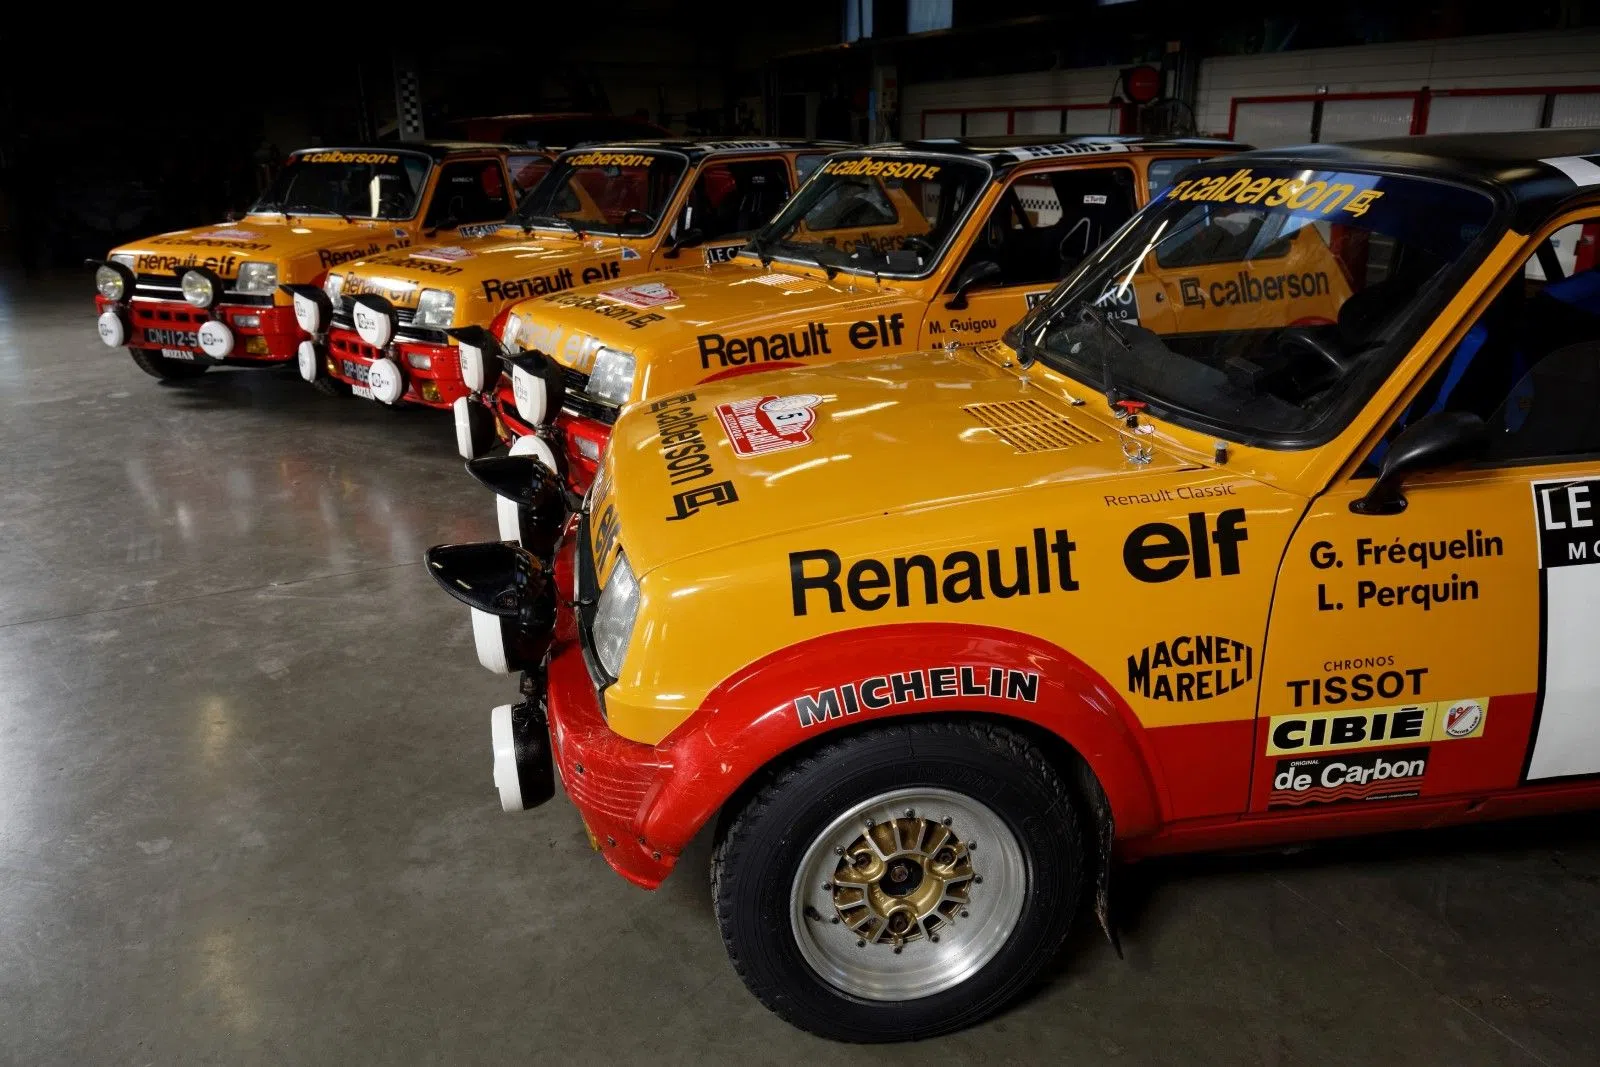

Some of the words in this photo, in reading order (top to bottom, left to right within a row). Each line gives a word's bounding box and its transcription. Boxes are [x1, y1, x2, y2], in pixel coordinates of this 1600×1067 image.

[311, 150, 388, 164] calberson
[571, 152, 643, 167] calberson
[831, 157, 927, 179] calberson
[1179, 168, 1355, 214] calberson
[204, 256, 237, 276] elf
[482, 270, 573, 302] Renault
[583, 261, 620, 284] elf
[1209, 270, 1330, 308] calberson
[698, 321, 832, 370] Renault
[849, 312, 905, 350] elf
[930, 321, 946, 335] M.
[950, 317, 997, 333] Guigou
[656, 404, 715, 487] calberson
[1104, 488, 1174, 507] Renault
[1176, 483, 1236, 500] Classic
[1541, 485, 1594, 531] LE
[789, 527, 1079, 616] Renault
[1123, 508, 1248, 584] elf
[1310, 541, 1343, 569] G.
[1356, 529, 1504, 570] Fréquelin
[1318, 583, 1343, 611] L.
[1358, 573, 1479, 611] Perquin
[1127, 635, 1252, 686] MAGNETI
[1127, 654, 1252, 702] MARELLI
[1323, 655, 1394, 672] CHRONOS
[793, 665, 1040, 729] MICHELIN
[1286, 667, 1428, 707] TISSOT
[1272, 706, 1425, 749] CIBIÉ
[1274, 765, 1312, 791] de
[1320, 758, 1425, 788] Carbon
[1290, 759, 1320, 767] ORIGINAL
